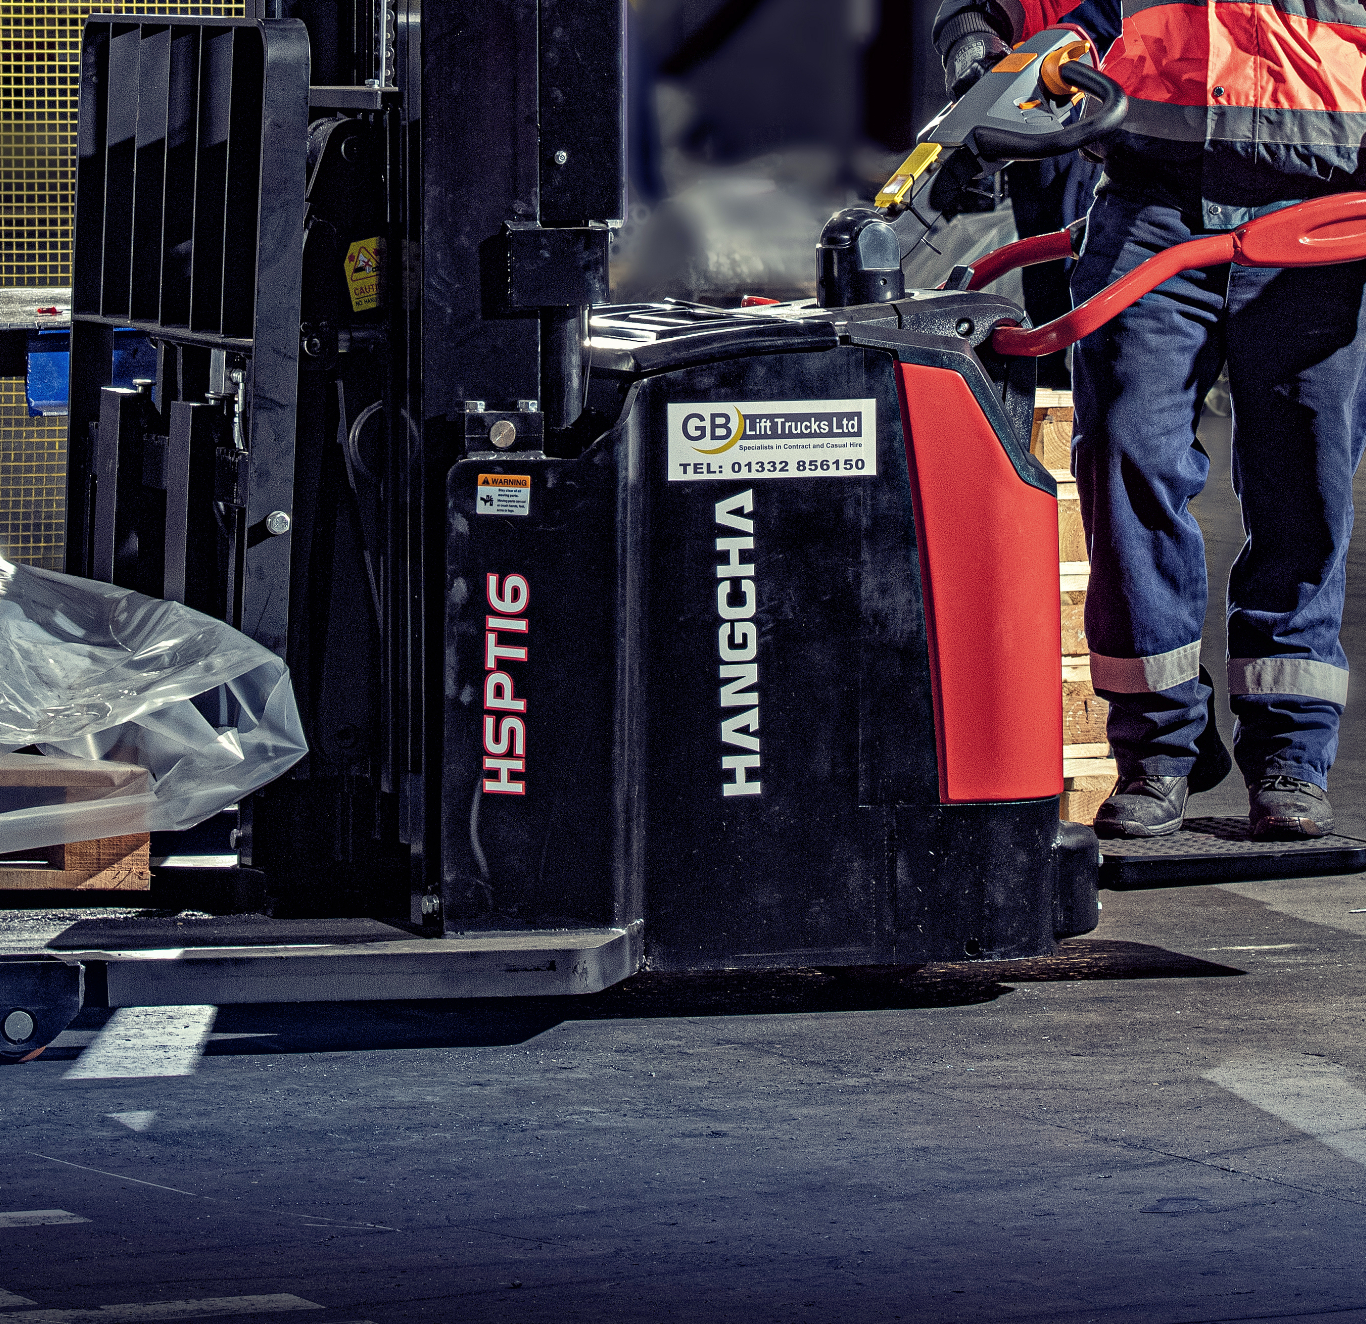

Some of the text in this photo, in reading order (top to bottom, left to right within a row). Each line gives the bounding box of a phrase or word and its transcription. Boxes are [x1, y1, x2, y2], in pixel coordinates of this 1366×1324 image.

[354, 283, 379, 296] CAUTI
[682, 413, 858, 442] GB Lift Trucks Ltd
[783, 442, 811, 450] Contract
[679, 459, 865, 474] TEL: 01332 856150
[491, 478, 527, 486] WARNING
[715, 489, 761, 797] HANGCHA
